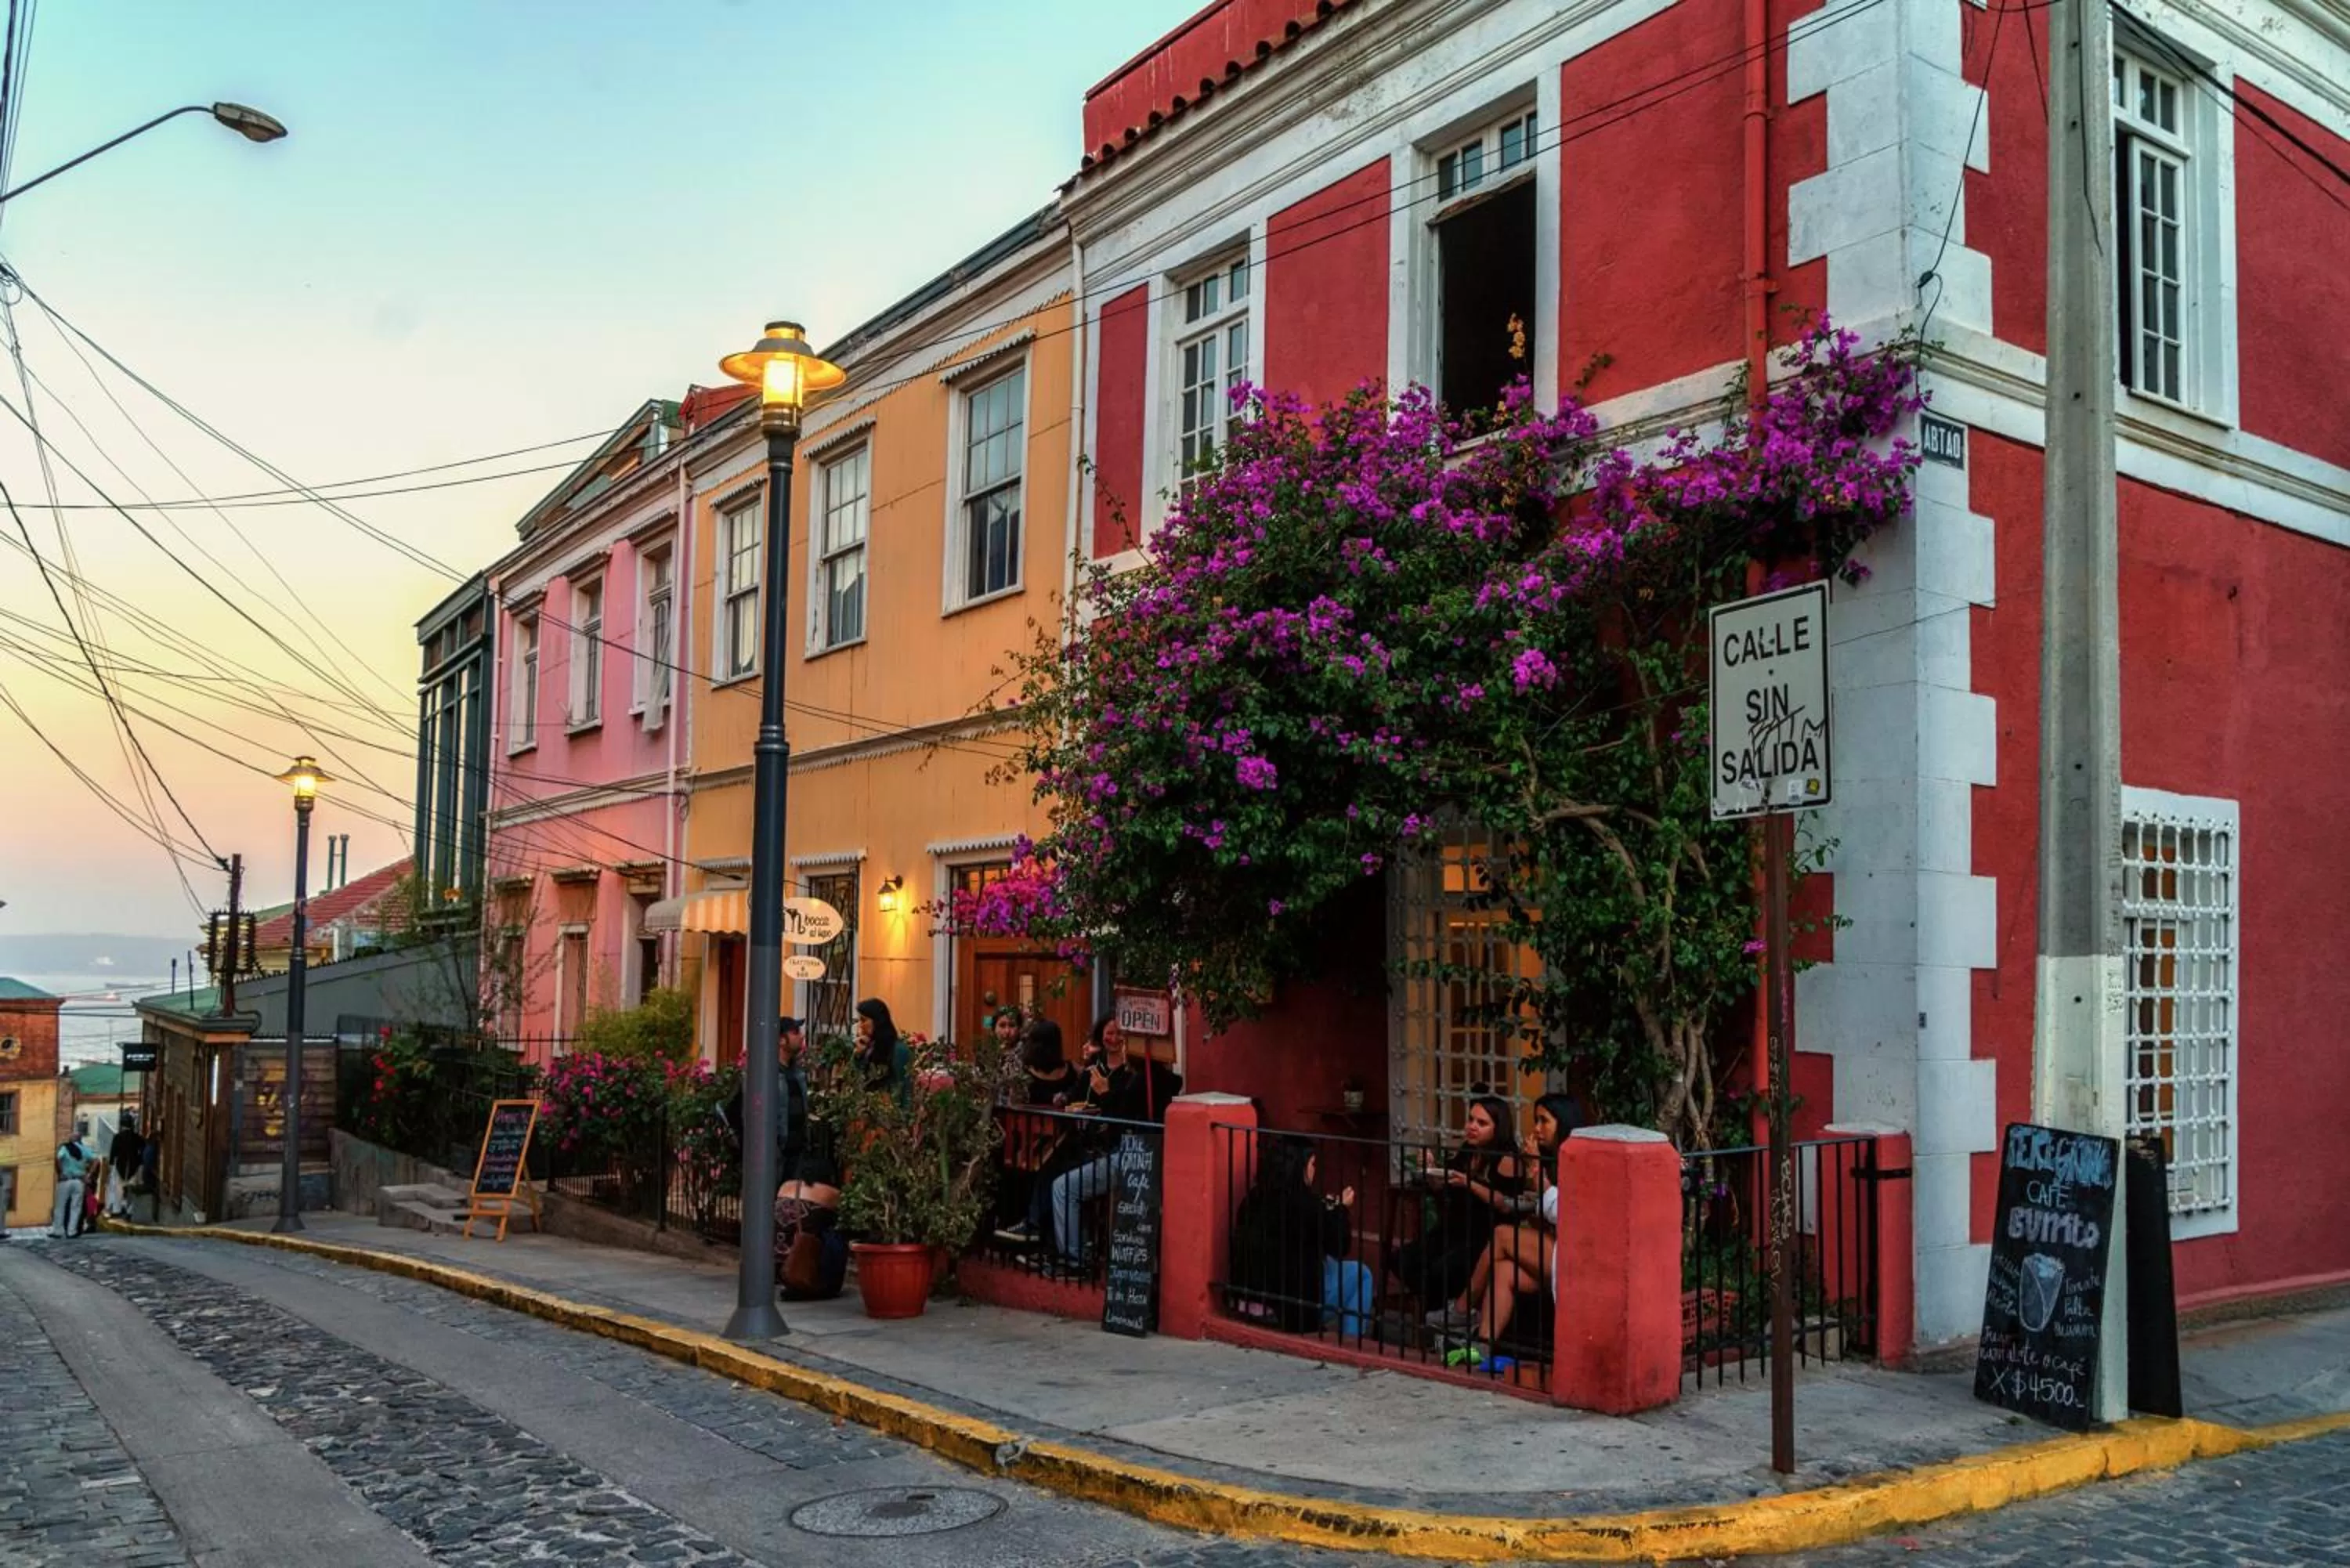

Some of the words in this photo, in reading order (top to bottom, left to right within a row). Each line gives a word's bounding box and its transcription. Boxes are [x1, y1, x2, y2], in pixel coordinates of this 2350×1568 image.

[1923, 423, 1961, 459] ABTAO
[1723, 616, 1810, 667] CALLE
[1746, 683, 1789, 724] SIN
[1722, 738, 1820, 784] SALIDA
[1121, 1010, 1160, 1030] OPEN
